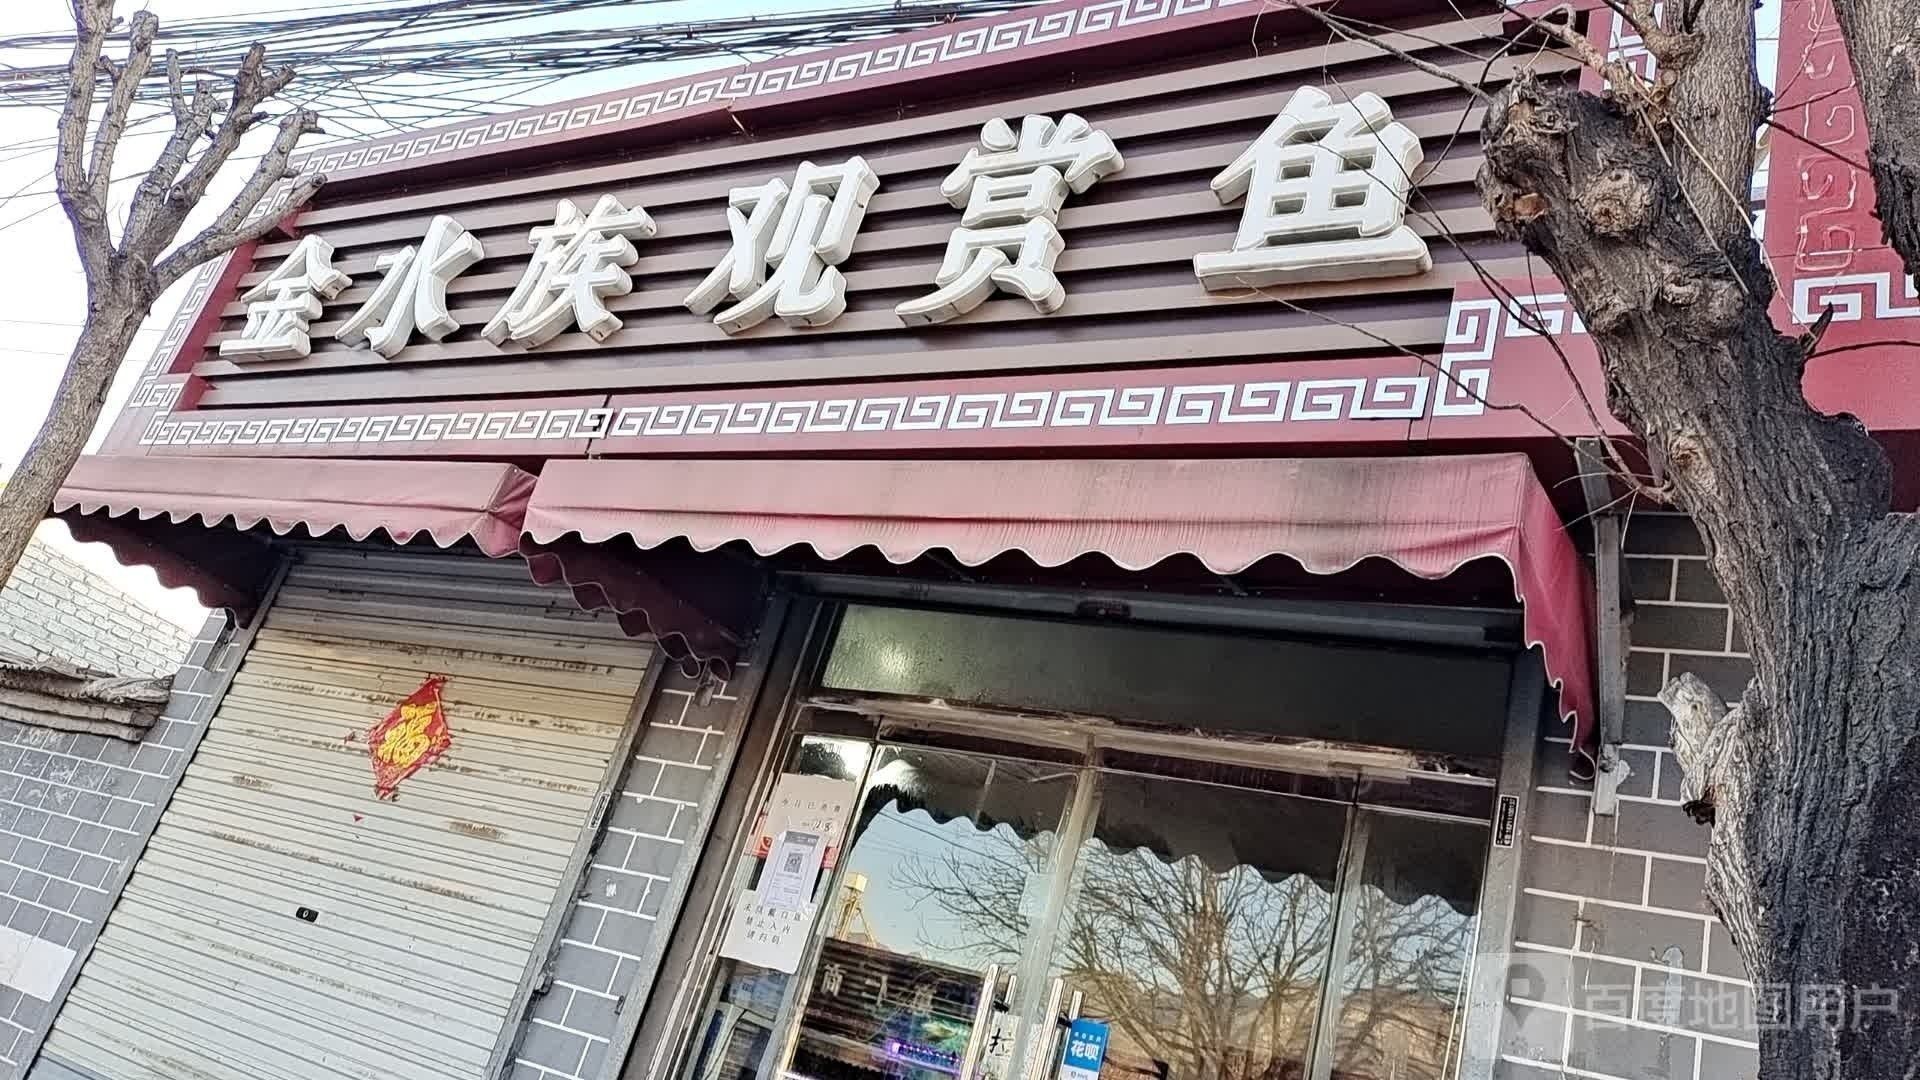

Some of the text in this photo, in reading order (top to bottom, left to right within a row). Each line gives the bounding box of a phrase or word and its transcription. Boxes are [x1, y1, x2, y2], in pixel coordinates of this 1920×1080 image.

[219, 85, 1432, 364] 金水族观赏鱼
[377, 702, 437, 768] 福
[1071, 1040, 1100, 1061] 花呗
